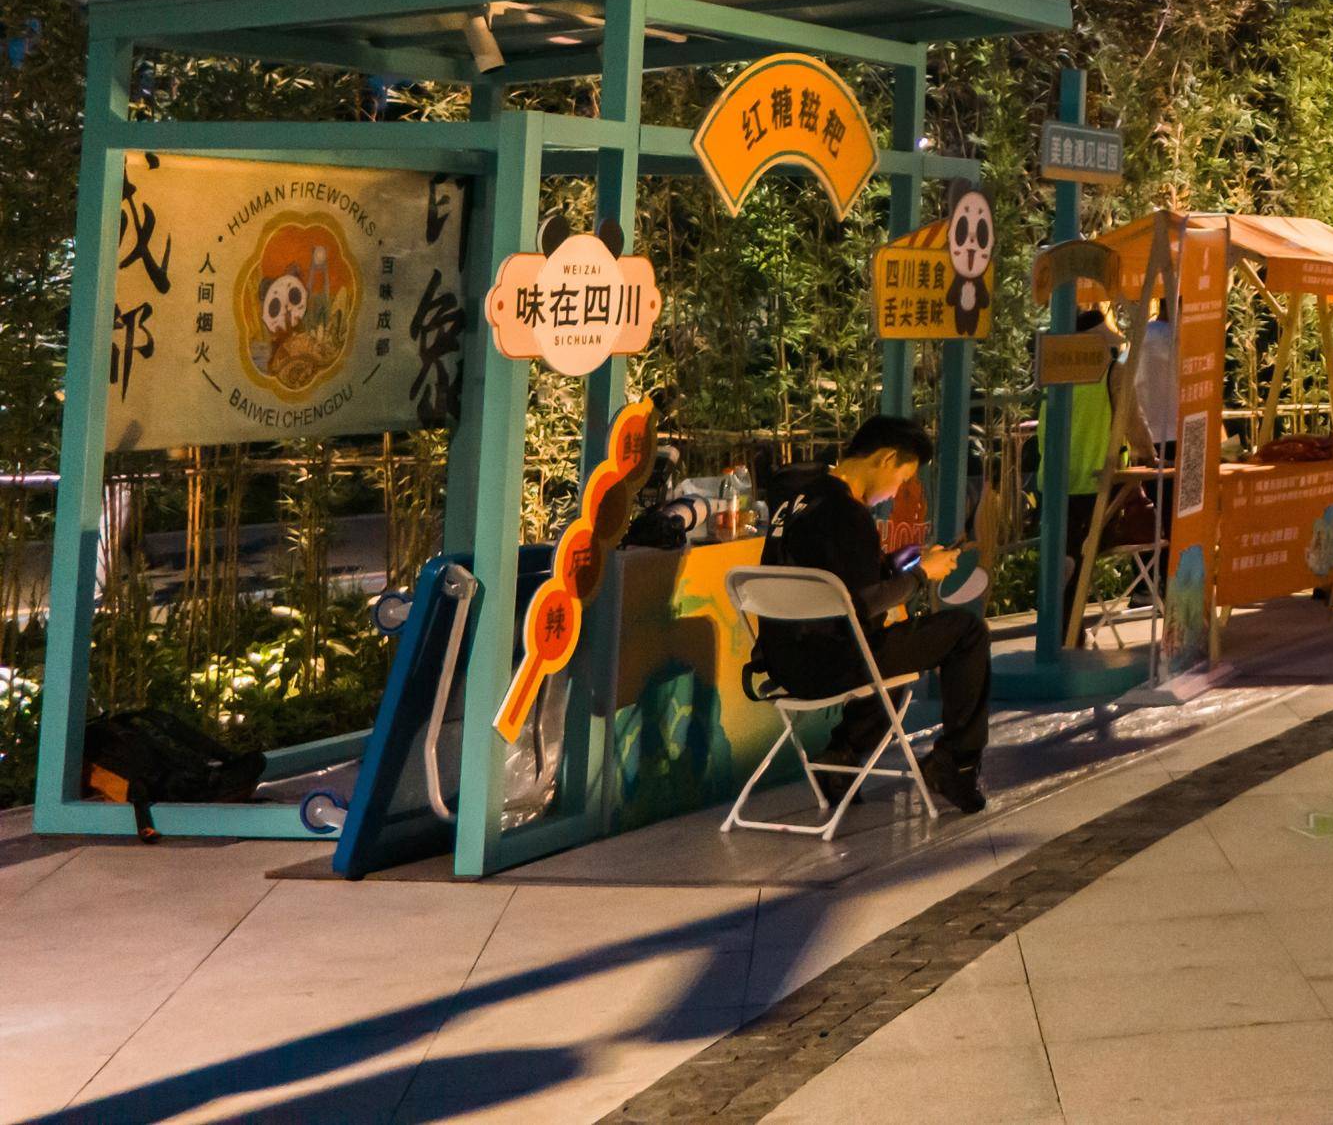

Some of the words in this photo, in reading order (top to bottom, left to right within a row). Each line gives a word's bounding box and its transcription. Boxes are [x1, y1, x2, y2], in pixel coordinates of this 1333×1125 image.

[741, 86, 847, 159] 红糖糍粑
[1050, 137, 1119, 171] 美食遇见世园
[227, 184, 286, 236] HUMAN
[289, 181, 377, 238] FIREWORKS
[563, 264, 601, 275] WEIZAI
[885, 259, 946, 290] 四川美食
[194, 252, 216, 365] 人间烟火
[516, 283, 641, 328] 味在四川
[884, 298, 944, 328] 舌尖美味
[554, 334, 602, 346] SICHUAN
[228, 388, 280, 427] BAIWEI
[282, 386, 353, 428] CHENGDU
